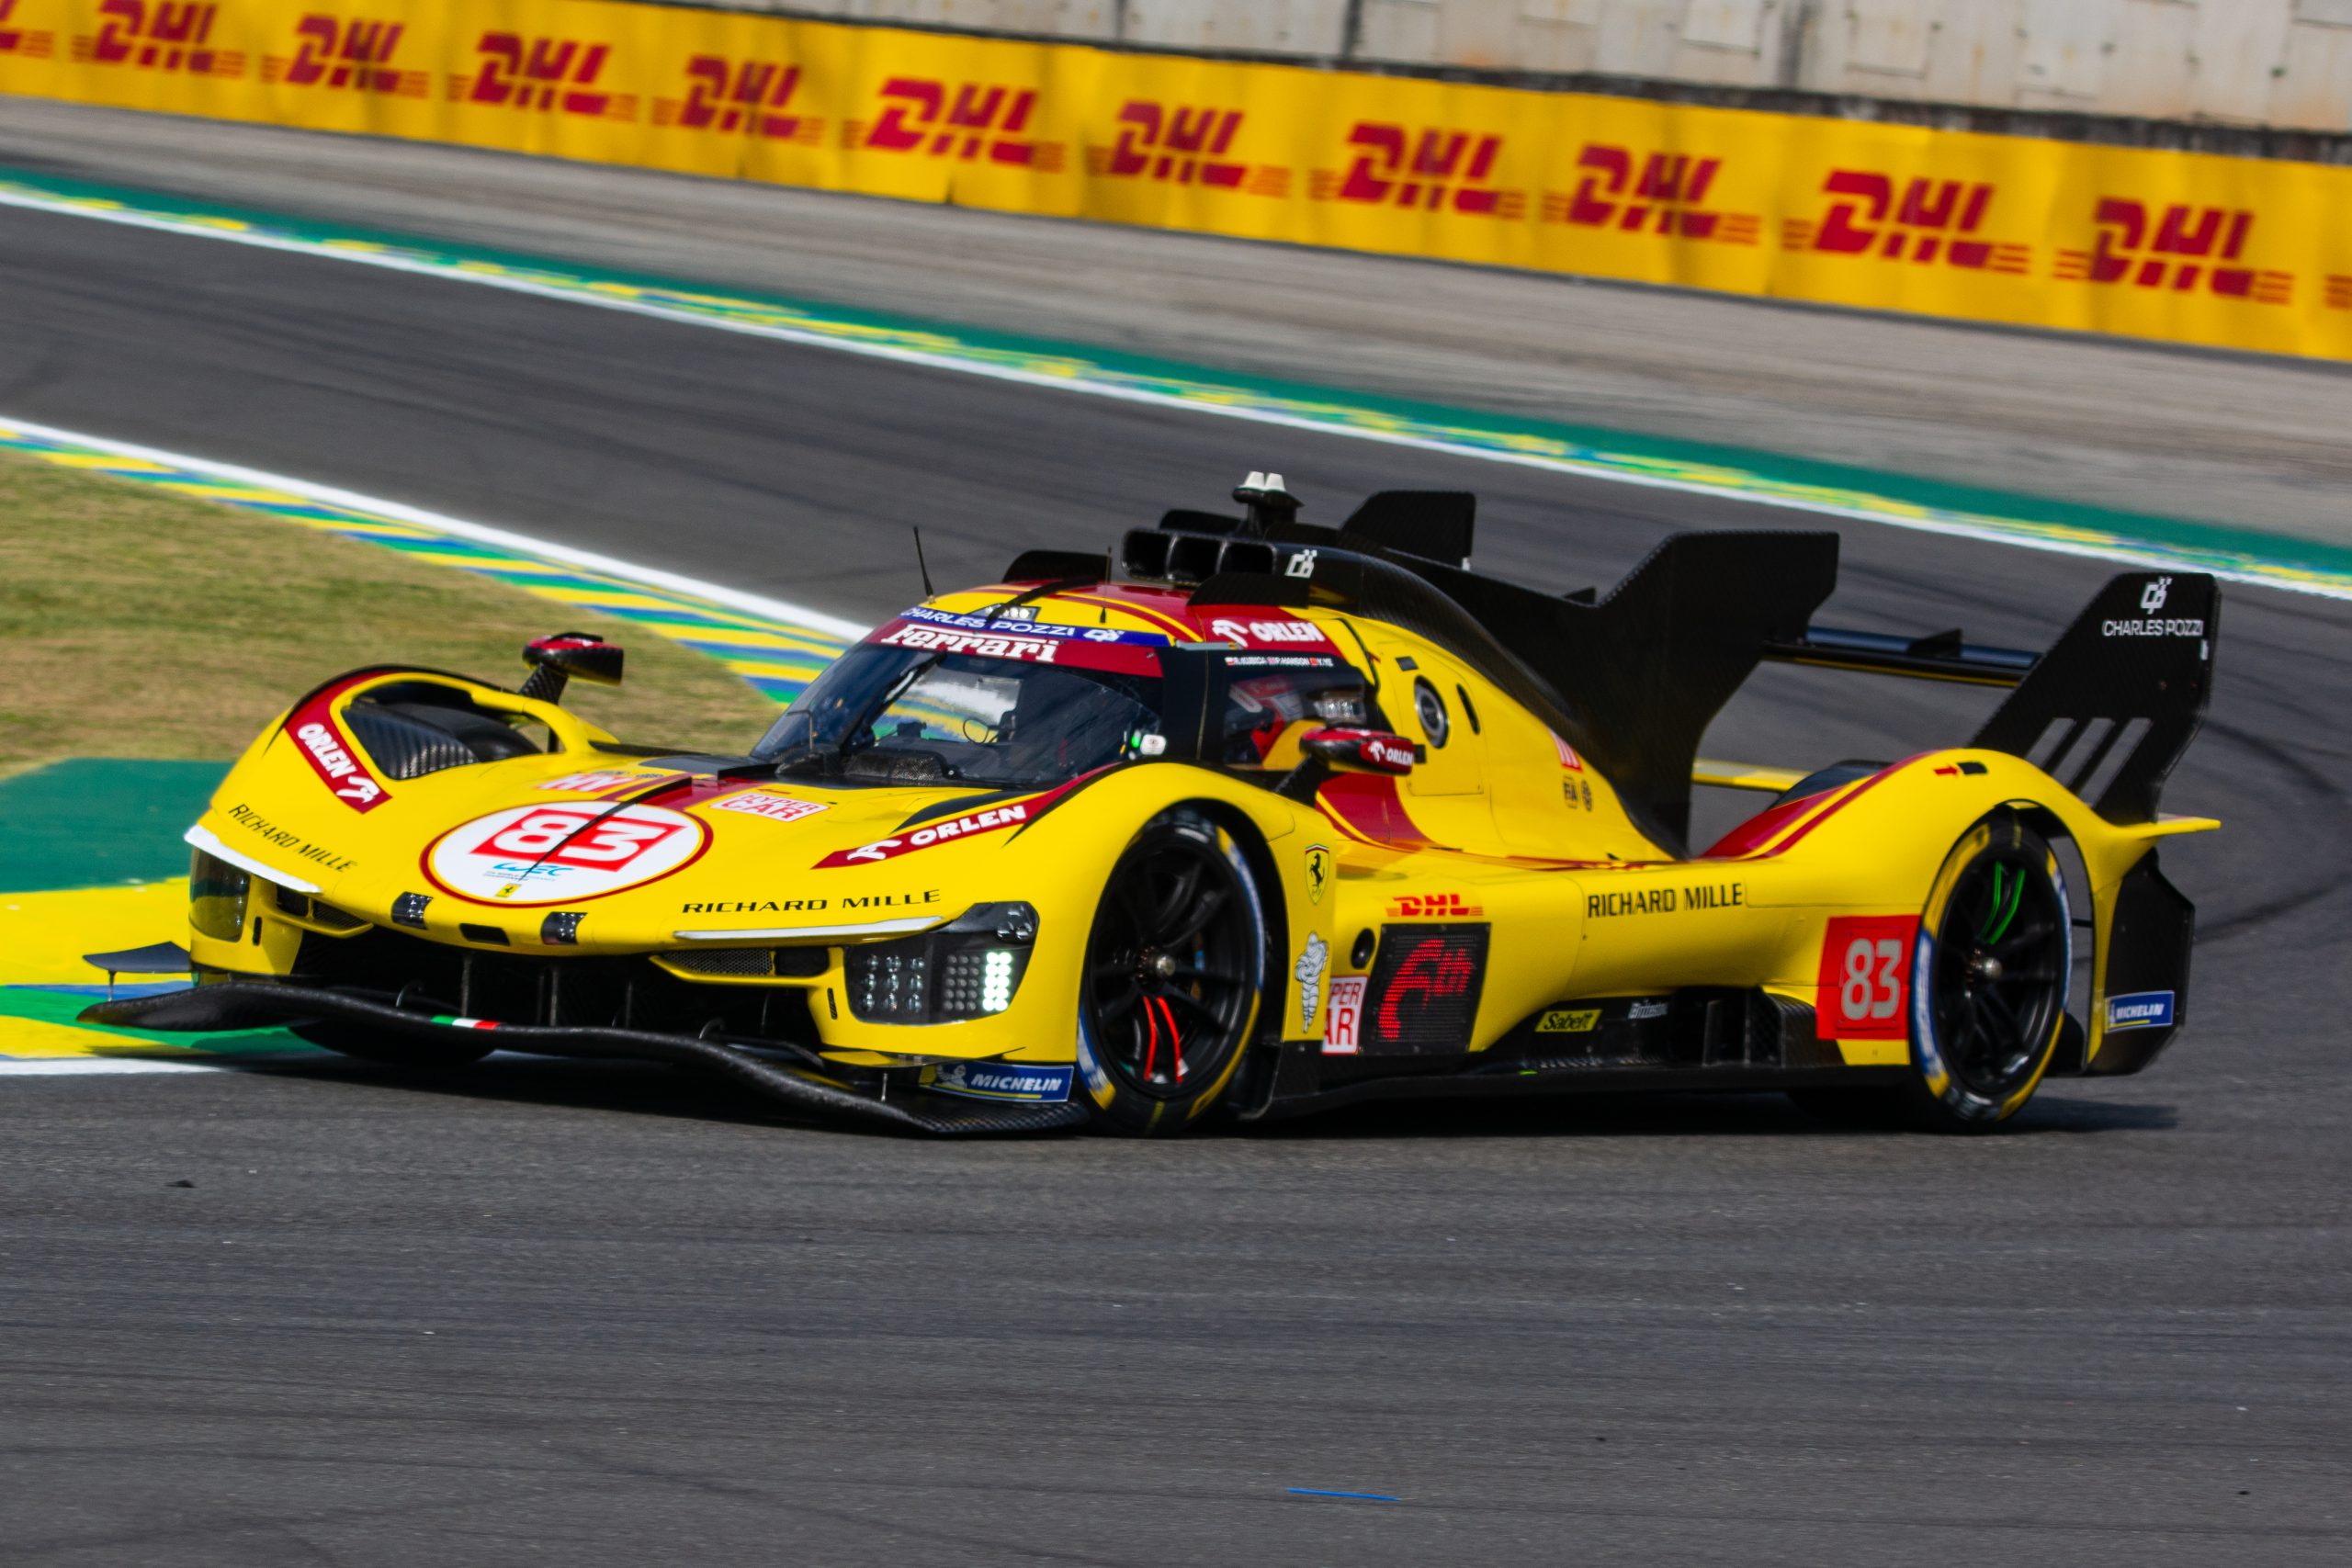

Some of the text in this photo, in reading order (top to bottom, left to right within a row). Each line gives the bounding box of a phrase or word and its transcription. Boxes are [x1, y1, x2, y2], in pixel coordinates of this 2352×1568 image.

[95, 0, 213, 73] DHL
[286, 16, 402, 93] DHL
[470, 33, 610, 116] DHL
[681, 56, 801, 139] DHL
[865, 78, 1035, 165] DHL
[1110, 101, 1247, 188] DHL
[1339, 122, 1501, 215] DHL
[1566, 144, 1720, 238] DHL
[1815, 170, 1992, 269] DHL
[2090, 197, 2254, 297] DHL
[882, 623, 1060, 663] Ferrari
[899, 606, 1075, 637] CHARLES POZZI
[1250, 621, 1325, 643] ORLEN
[2102, 619, 2203, 637] CHARLES POZZI
[297, 722, 357, 779] ORLEN
[1385, 747, 1414, 766] ORLEN
[720, 799, 804, 819] CAR
[740, 795, 820, 811] HYPER
[910, 805, 1027, 846] ORLEN
[228, 802, 358, 873] RICHARD MILLE
[492, 811, 668, 863] 83
[682, 889, 942, 914] RICHARD MILLE
[1392, 894, 1470, 917] DHL
[1588, 882, 1743, 919] RICHARD MILLE
[1840, 938, 1904, 1021] 83
[1544, 1012, 1593, 1030] Sabelt
[2115, 1002, 2165, 1020] MICHELIN
[970, 1073, 1063, 1092] MICHELIN
